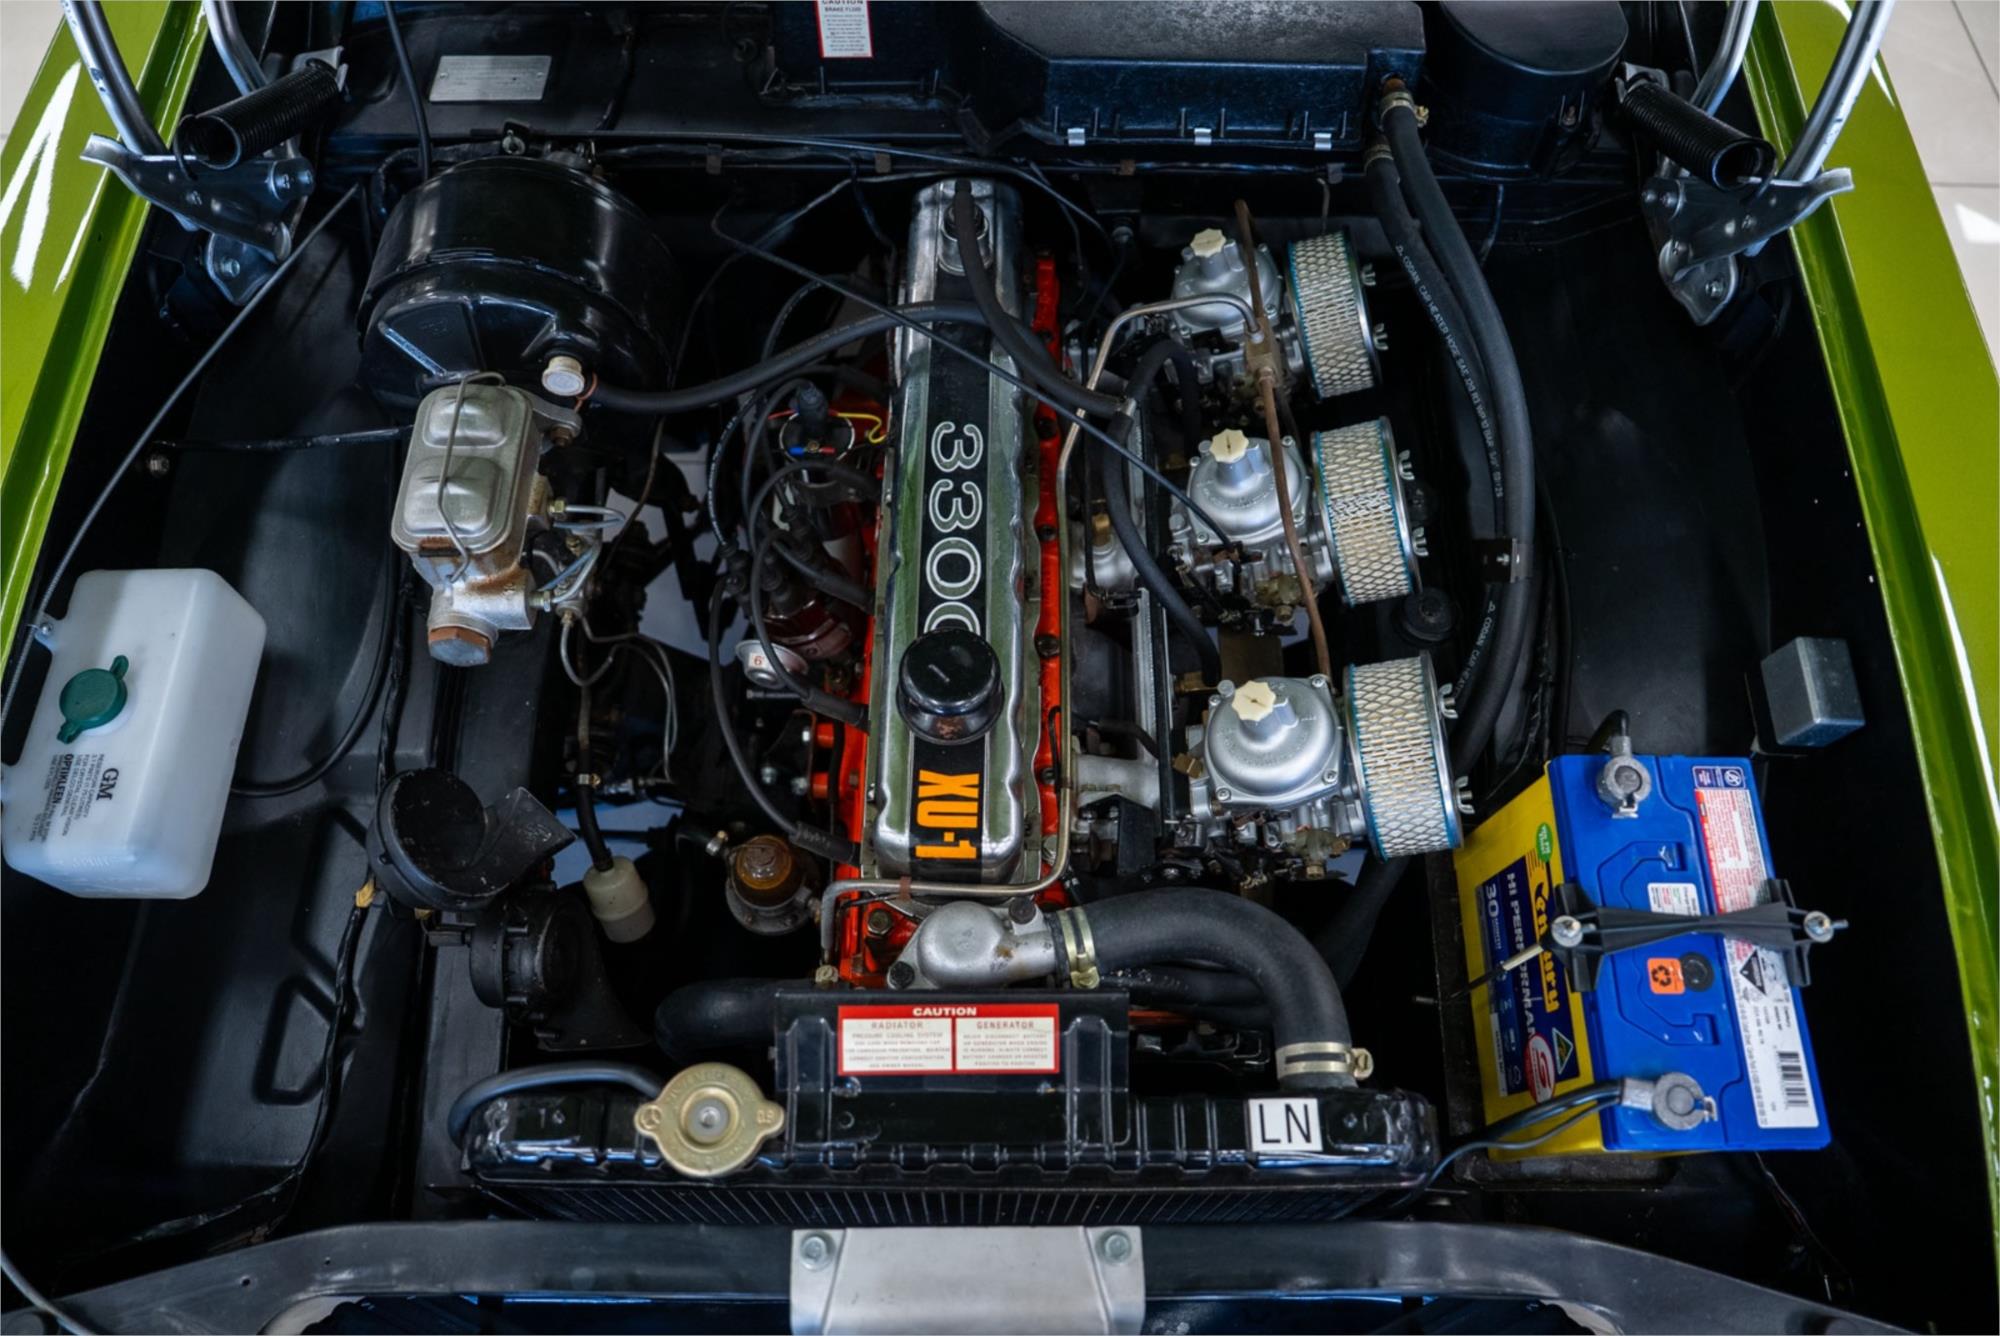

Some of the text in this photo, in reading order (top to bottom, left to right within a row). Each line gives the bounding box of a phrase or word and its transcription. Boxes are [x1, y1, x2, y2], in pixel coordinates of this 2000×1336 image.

[52, 753, 74, 804] OPTIKLEEN
[96, 767, 119, 801] GM
[915, 769, 980, 859] XU-1
[1485, 883, 1500, 918] 30
[1507, 873, 1518, 896] HI
[871, 1021, 924, 1030] RADIATOR
[912, 1007, 977, 1016] CAUTION
[976, 1021, 1035, 1030] GENERATOR
[1258, 1103, 1312, 1144] LN
